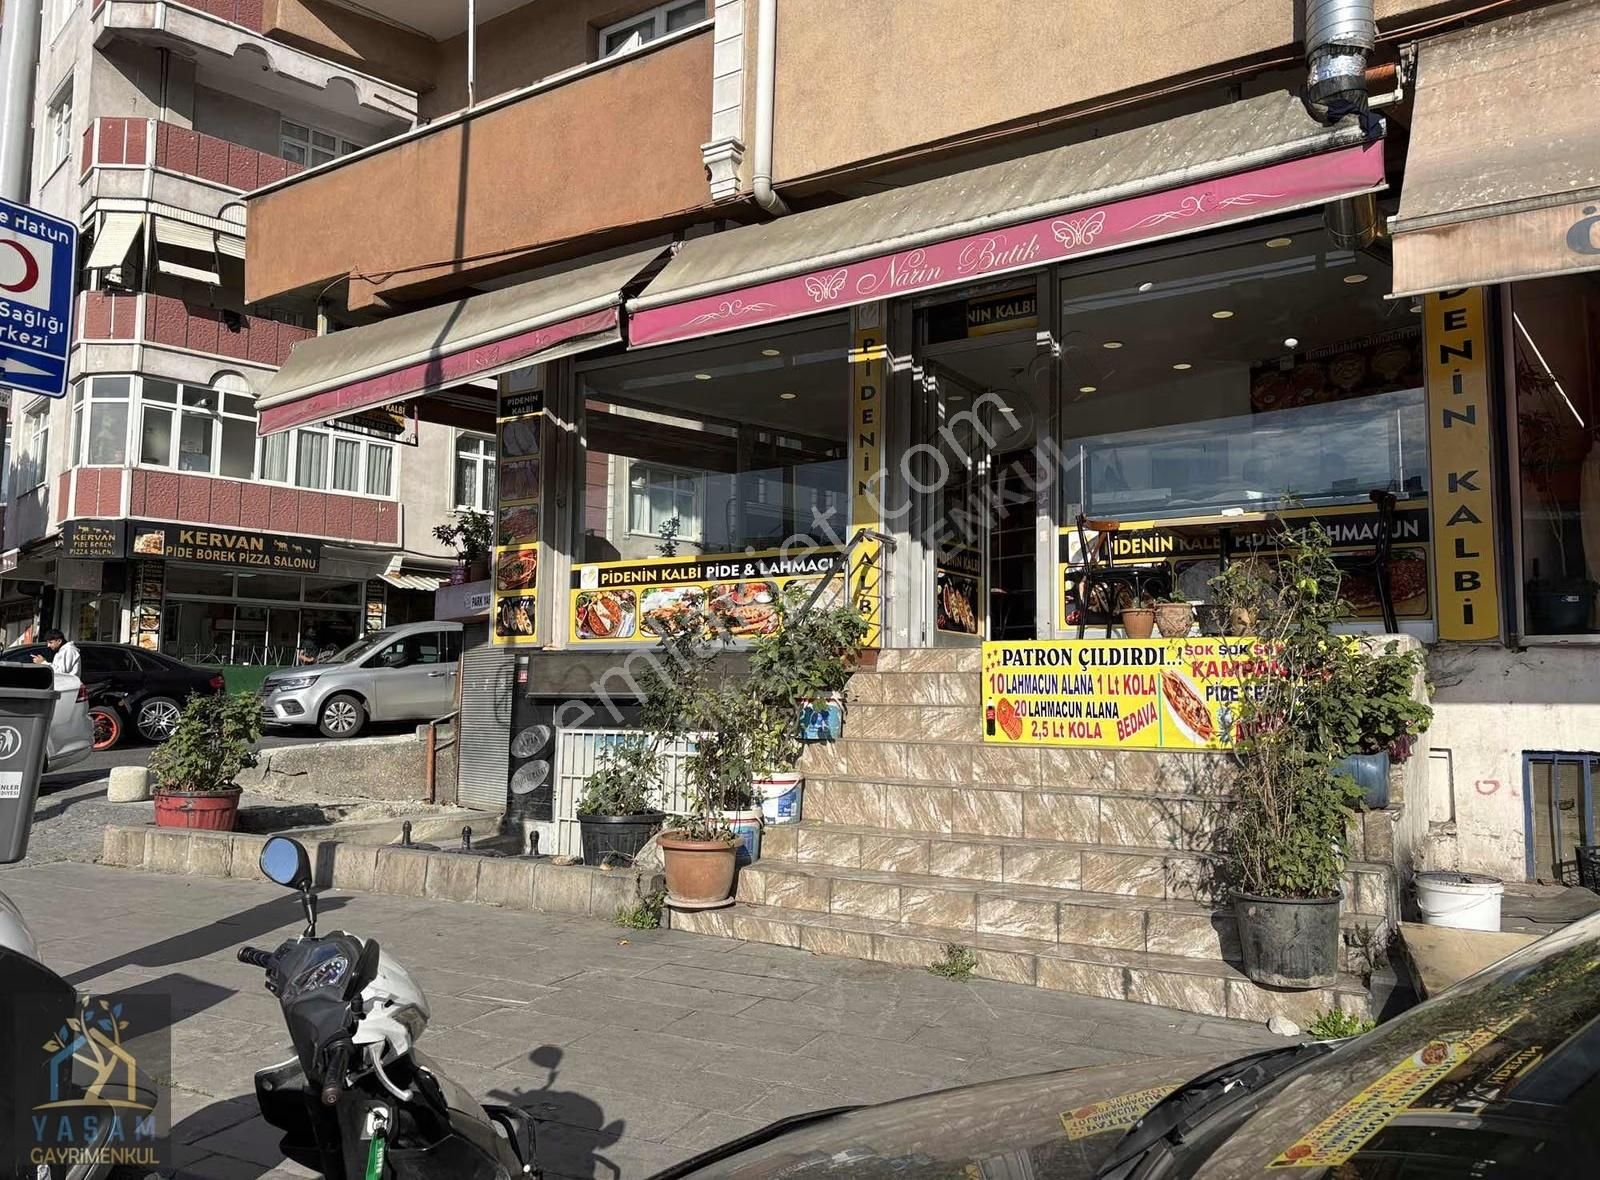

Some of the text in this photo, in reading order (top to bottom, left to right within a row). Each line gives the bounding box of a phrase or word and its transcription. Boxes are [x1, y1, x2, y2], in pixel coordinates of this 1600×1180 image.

[15, 215, 69, 244] Hatun
[958, 233, 1040, 274] Butik
[0, 301, 63, 334] Sağlığı
[0, 324, 48, 349] rkezi
[180, 529, 264, 551] KERVAN
[273, 556, 317, 569] SALONU
[601, 568, 657, 585] PİDENİN
[661, 563, 702, 581] KALBİ
[705, 561, 740, 579] PİDE
[744, 563, 755, 576] &
[1002, 648, 1072, 666] PATRON
[989, 673, 1157, 696] 10 LAHMACUN ALANA 1 Lt KOLA
[1014, 700, 1119, 719] 20 LAHMACUN ALANA
[1031, 720, 1103, 740] 2,5 Lt KOLA
[1116, 701, 1158, 742] BEDAVA
